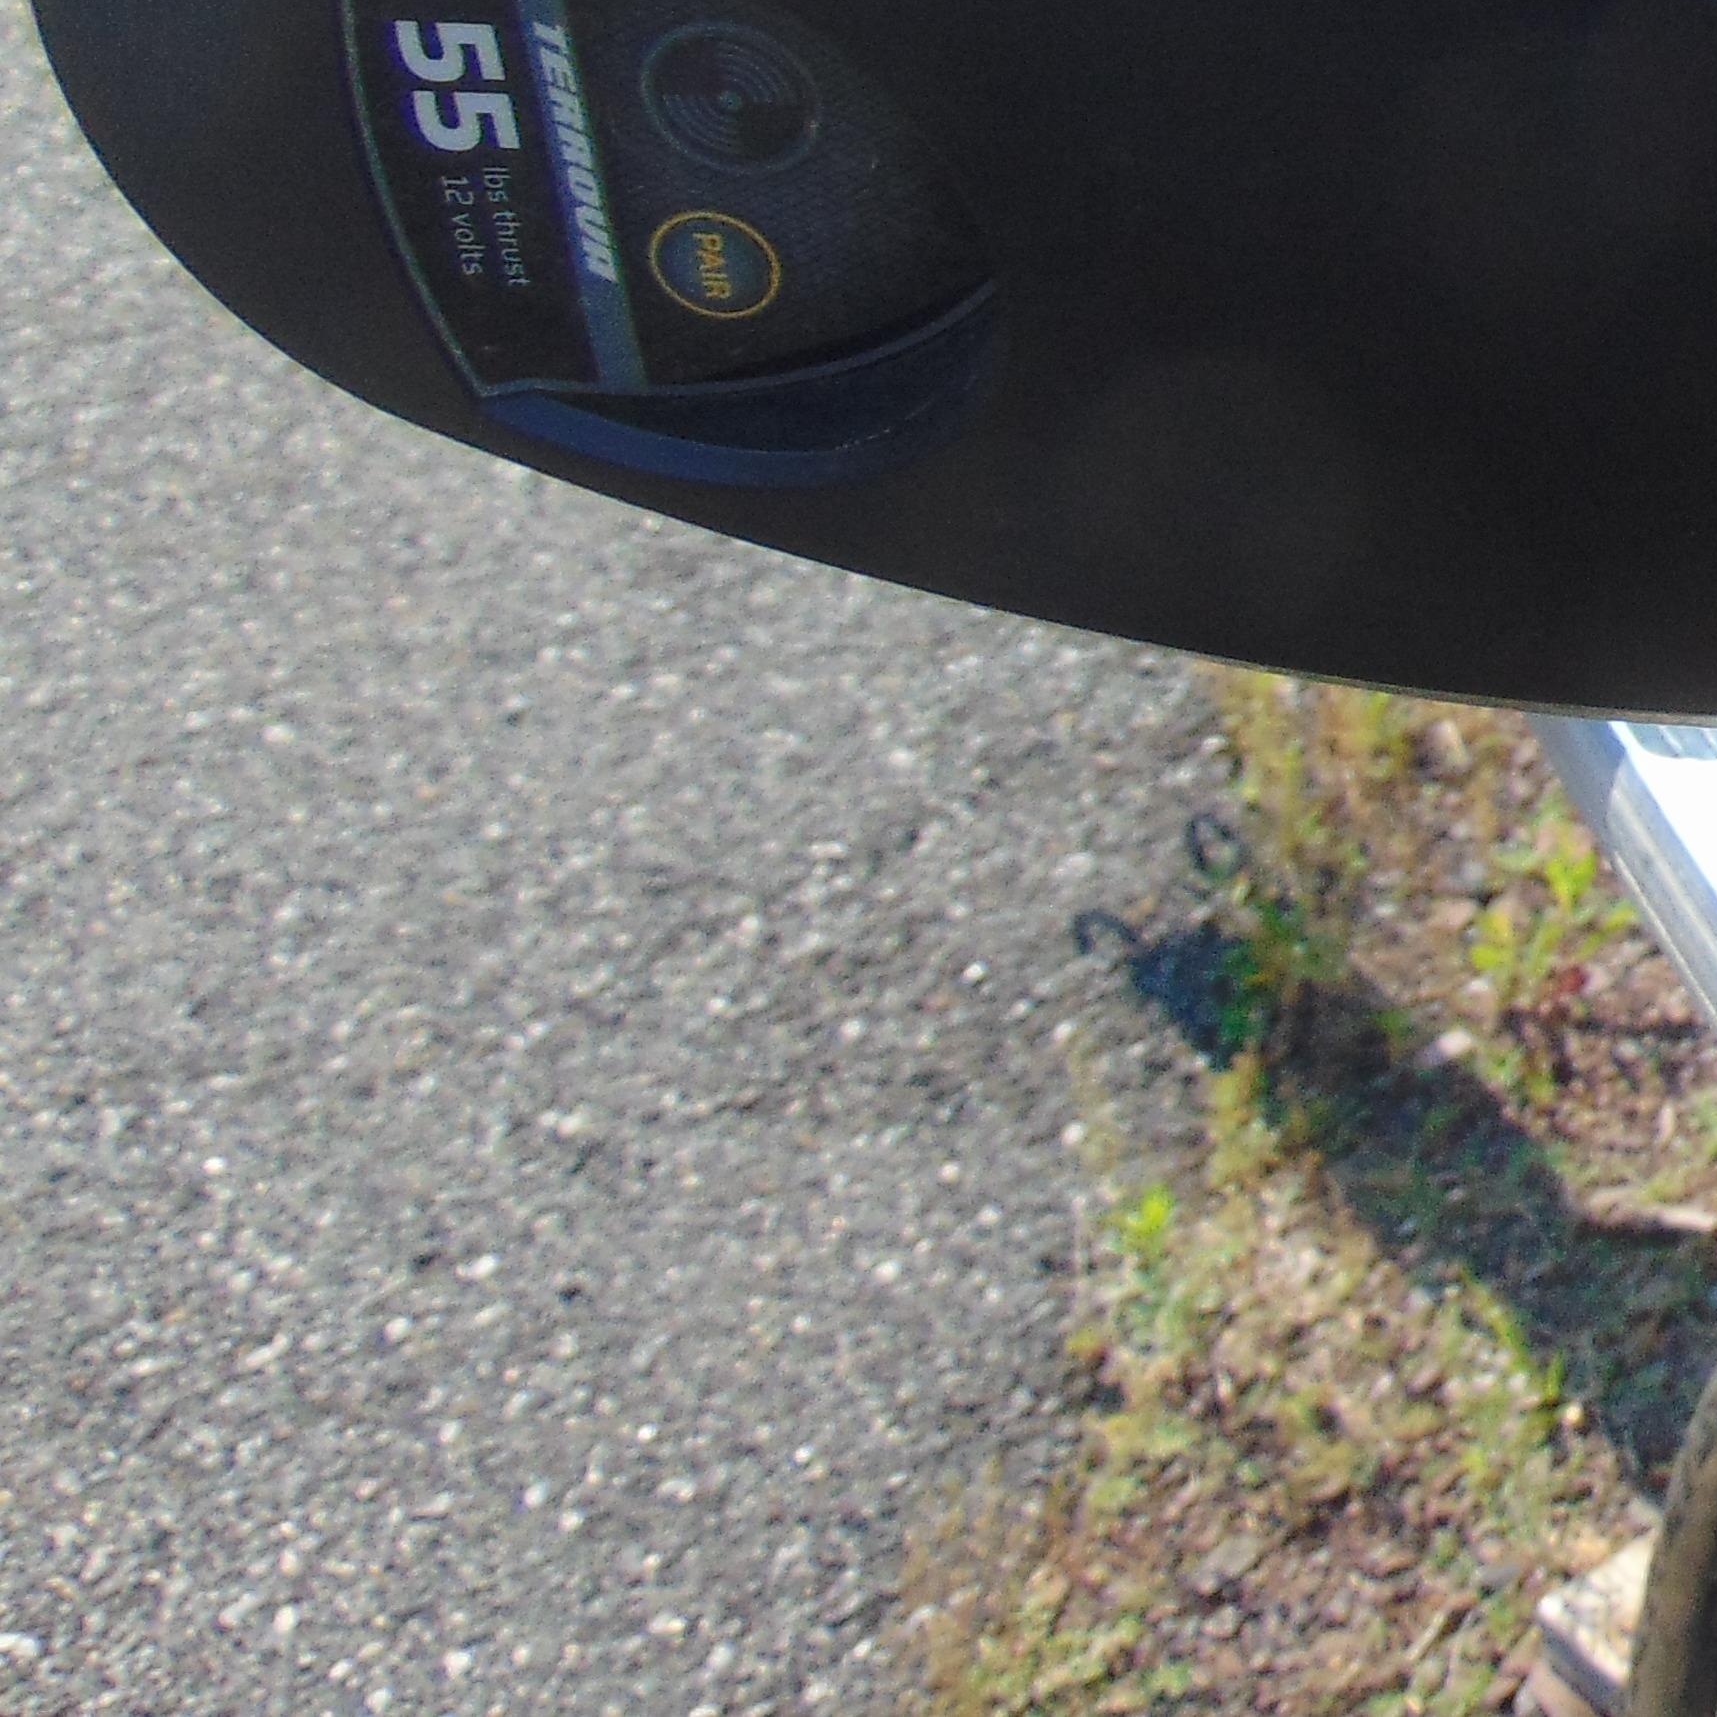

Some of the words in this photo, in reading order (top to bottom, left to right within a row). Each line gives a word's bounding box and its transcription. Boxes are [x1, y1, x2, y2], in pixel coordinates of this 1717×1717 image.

[395, 20, 521, 151] 55
[482, 166, 514, 203] lbs
[533, 20, 619, 283] TERROVA
[440, 174, 474, 204] 12
[449, 210, 486, 277] volts
[491, 208, 531, 287] thrust
[691, 232, 731, 300] PAIR
